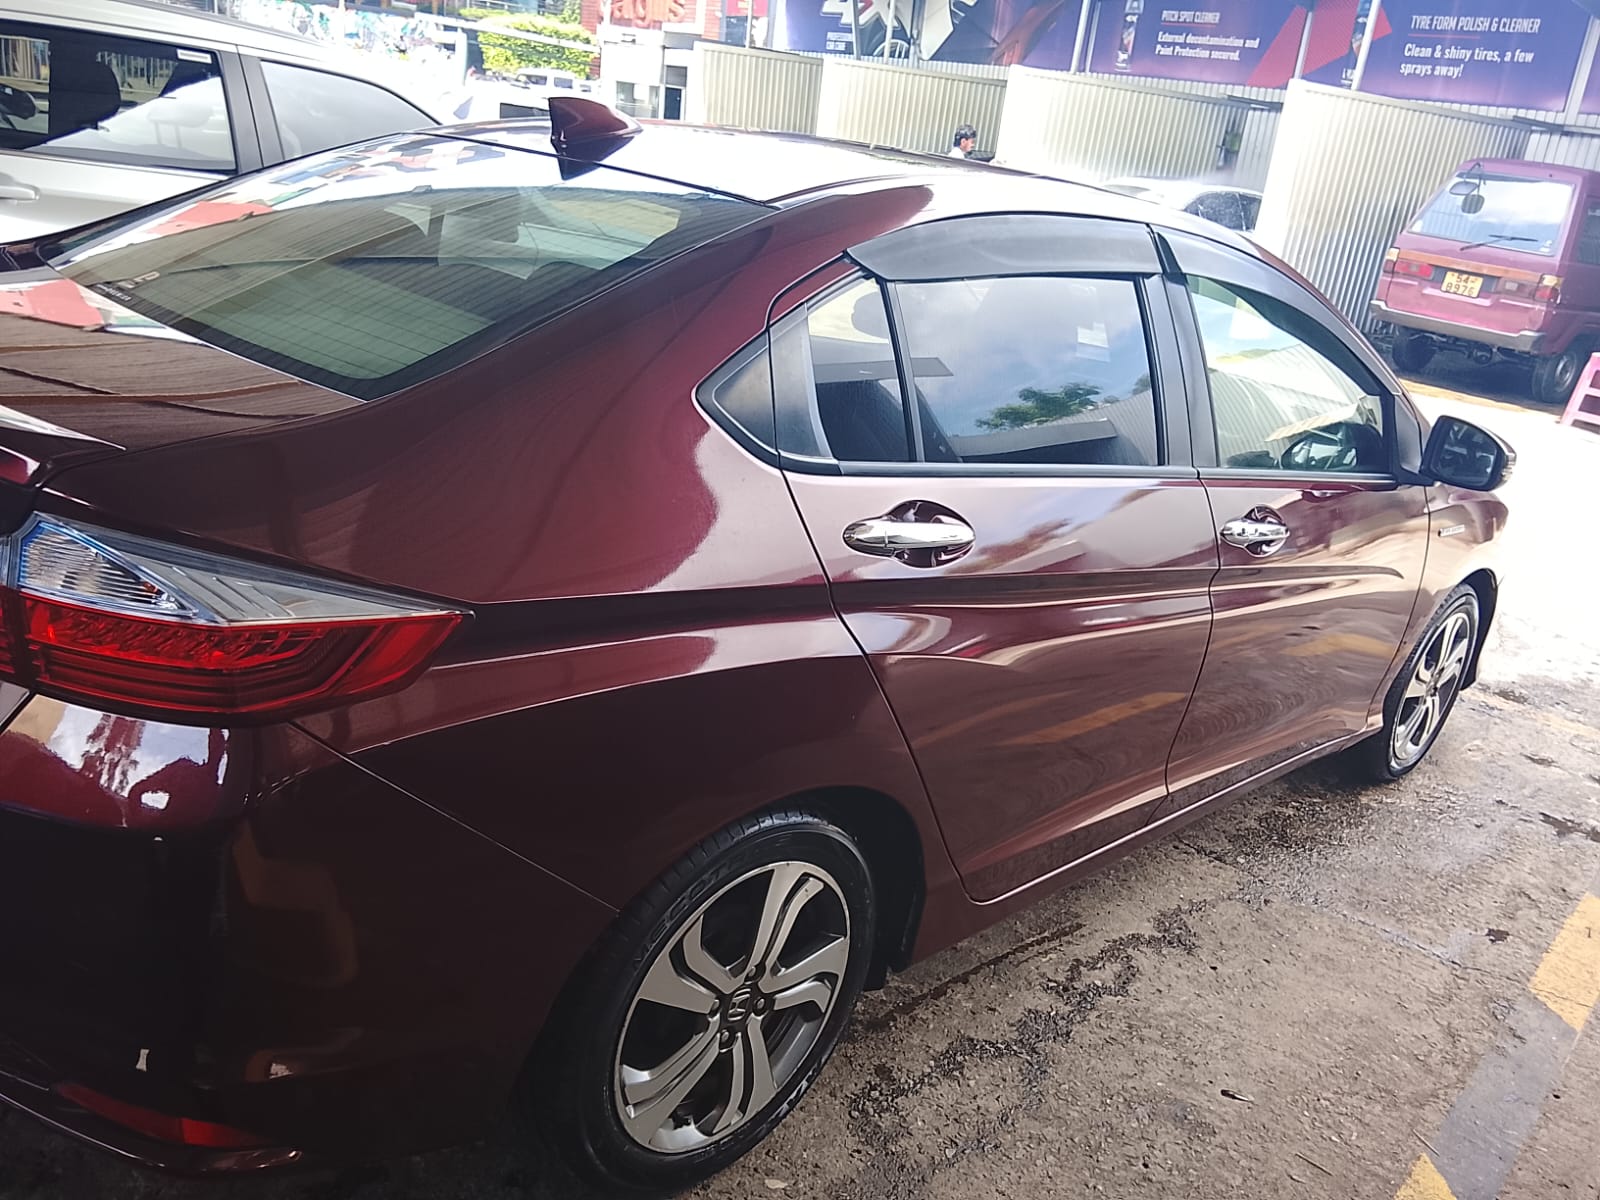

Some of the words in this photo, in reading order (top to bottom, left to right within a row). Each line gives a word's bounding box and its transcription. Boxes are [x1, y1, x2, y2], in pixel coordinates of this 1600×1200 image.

[1411, 15, 1432, 30] TYRE
[1457, 16, 1491, 32] POLISH
[1499, 17, 1541, 34] CLEANER
[1404, 43, 1432, 58] Clean
[1433, 44, 1442, 58] &
[1443, 45, 1472, 62] shiny
[1474, 47, 1501, 64] tires,
[1503, 51, 1512, 62] a
[1513, 48, 1535, 63] few
[1400, 63, 1432, 77] sprays
[1434, 63, 1464, 79] away!
